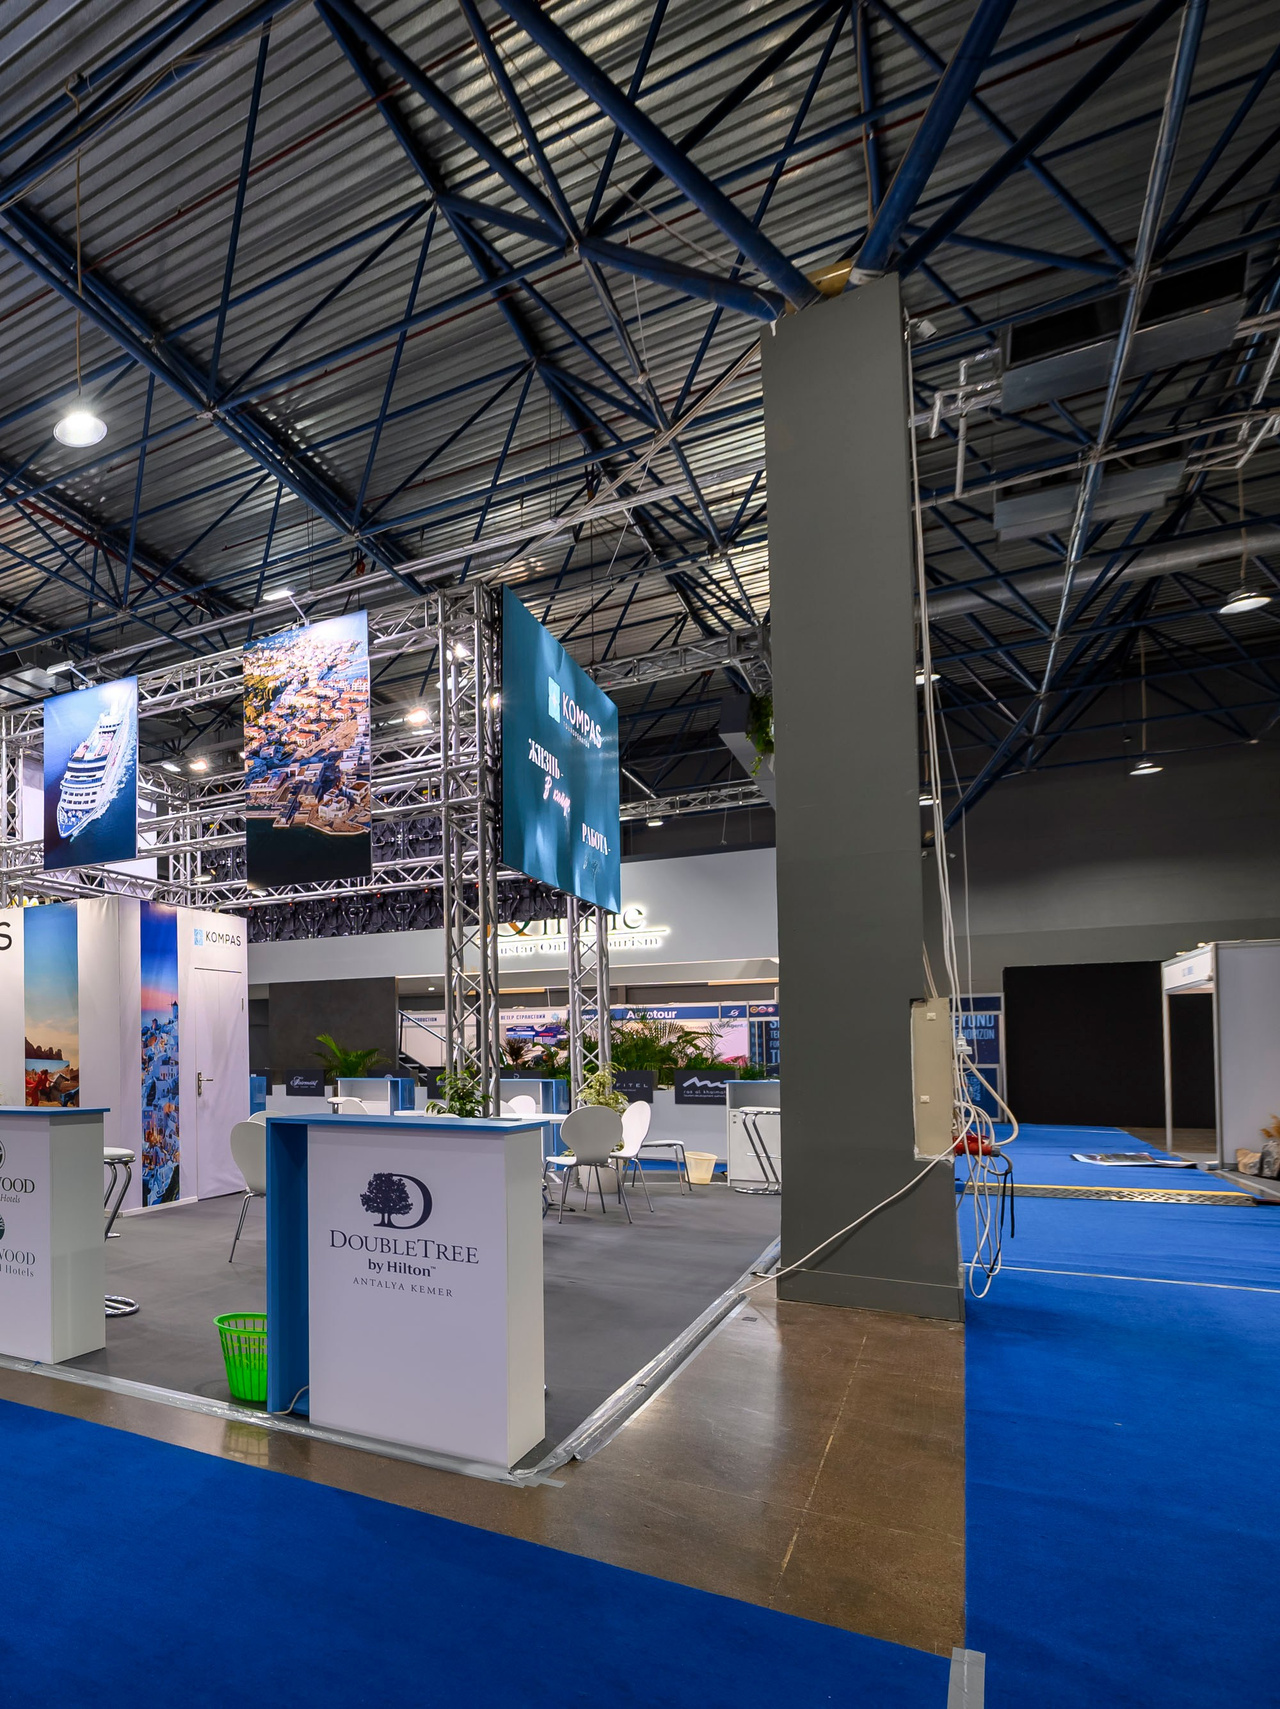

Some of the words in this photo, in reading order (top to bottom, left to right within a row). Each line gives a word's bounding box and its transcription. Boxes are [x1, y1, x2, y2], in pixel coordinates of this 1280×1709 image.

[562, 691, 602, 749] KOMPAS
[528, 738, 561, 780] ЖИЗНЬ
[581, 822, 609, 856] РАБОТА
[205, 930, 242, 947] KOMPAS
[607, 936, 659, 949] ourism
[0, 1194, 21, 1203] Hotels
[5, 1265, 35, 1278] Hotels
[368, 1258, 384, 1274] by
[352, 1276, 405, 1291] ANTALYA
[410, 1284, 454, 1298] KEMER
